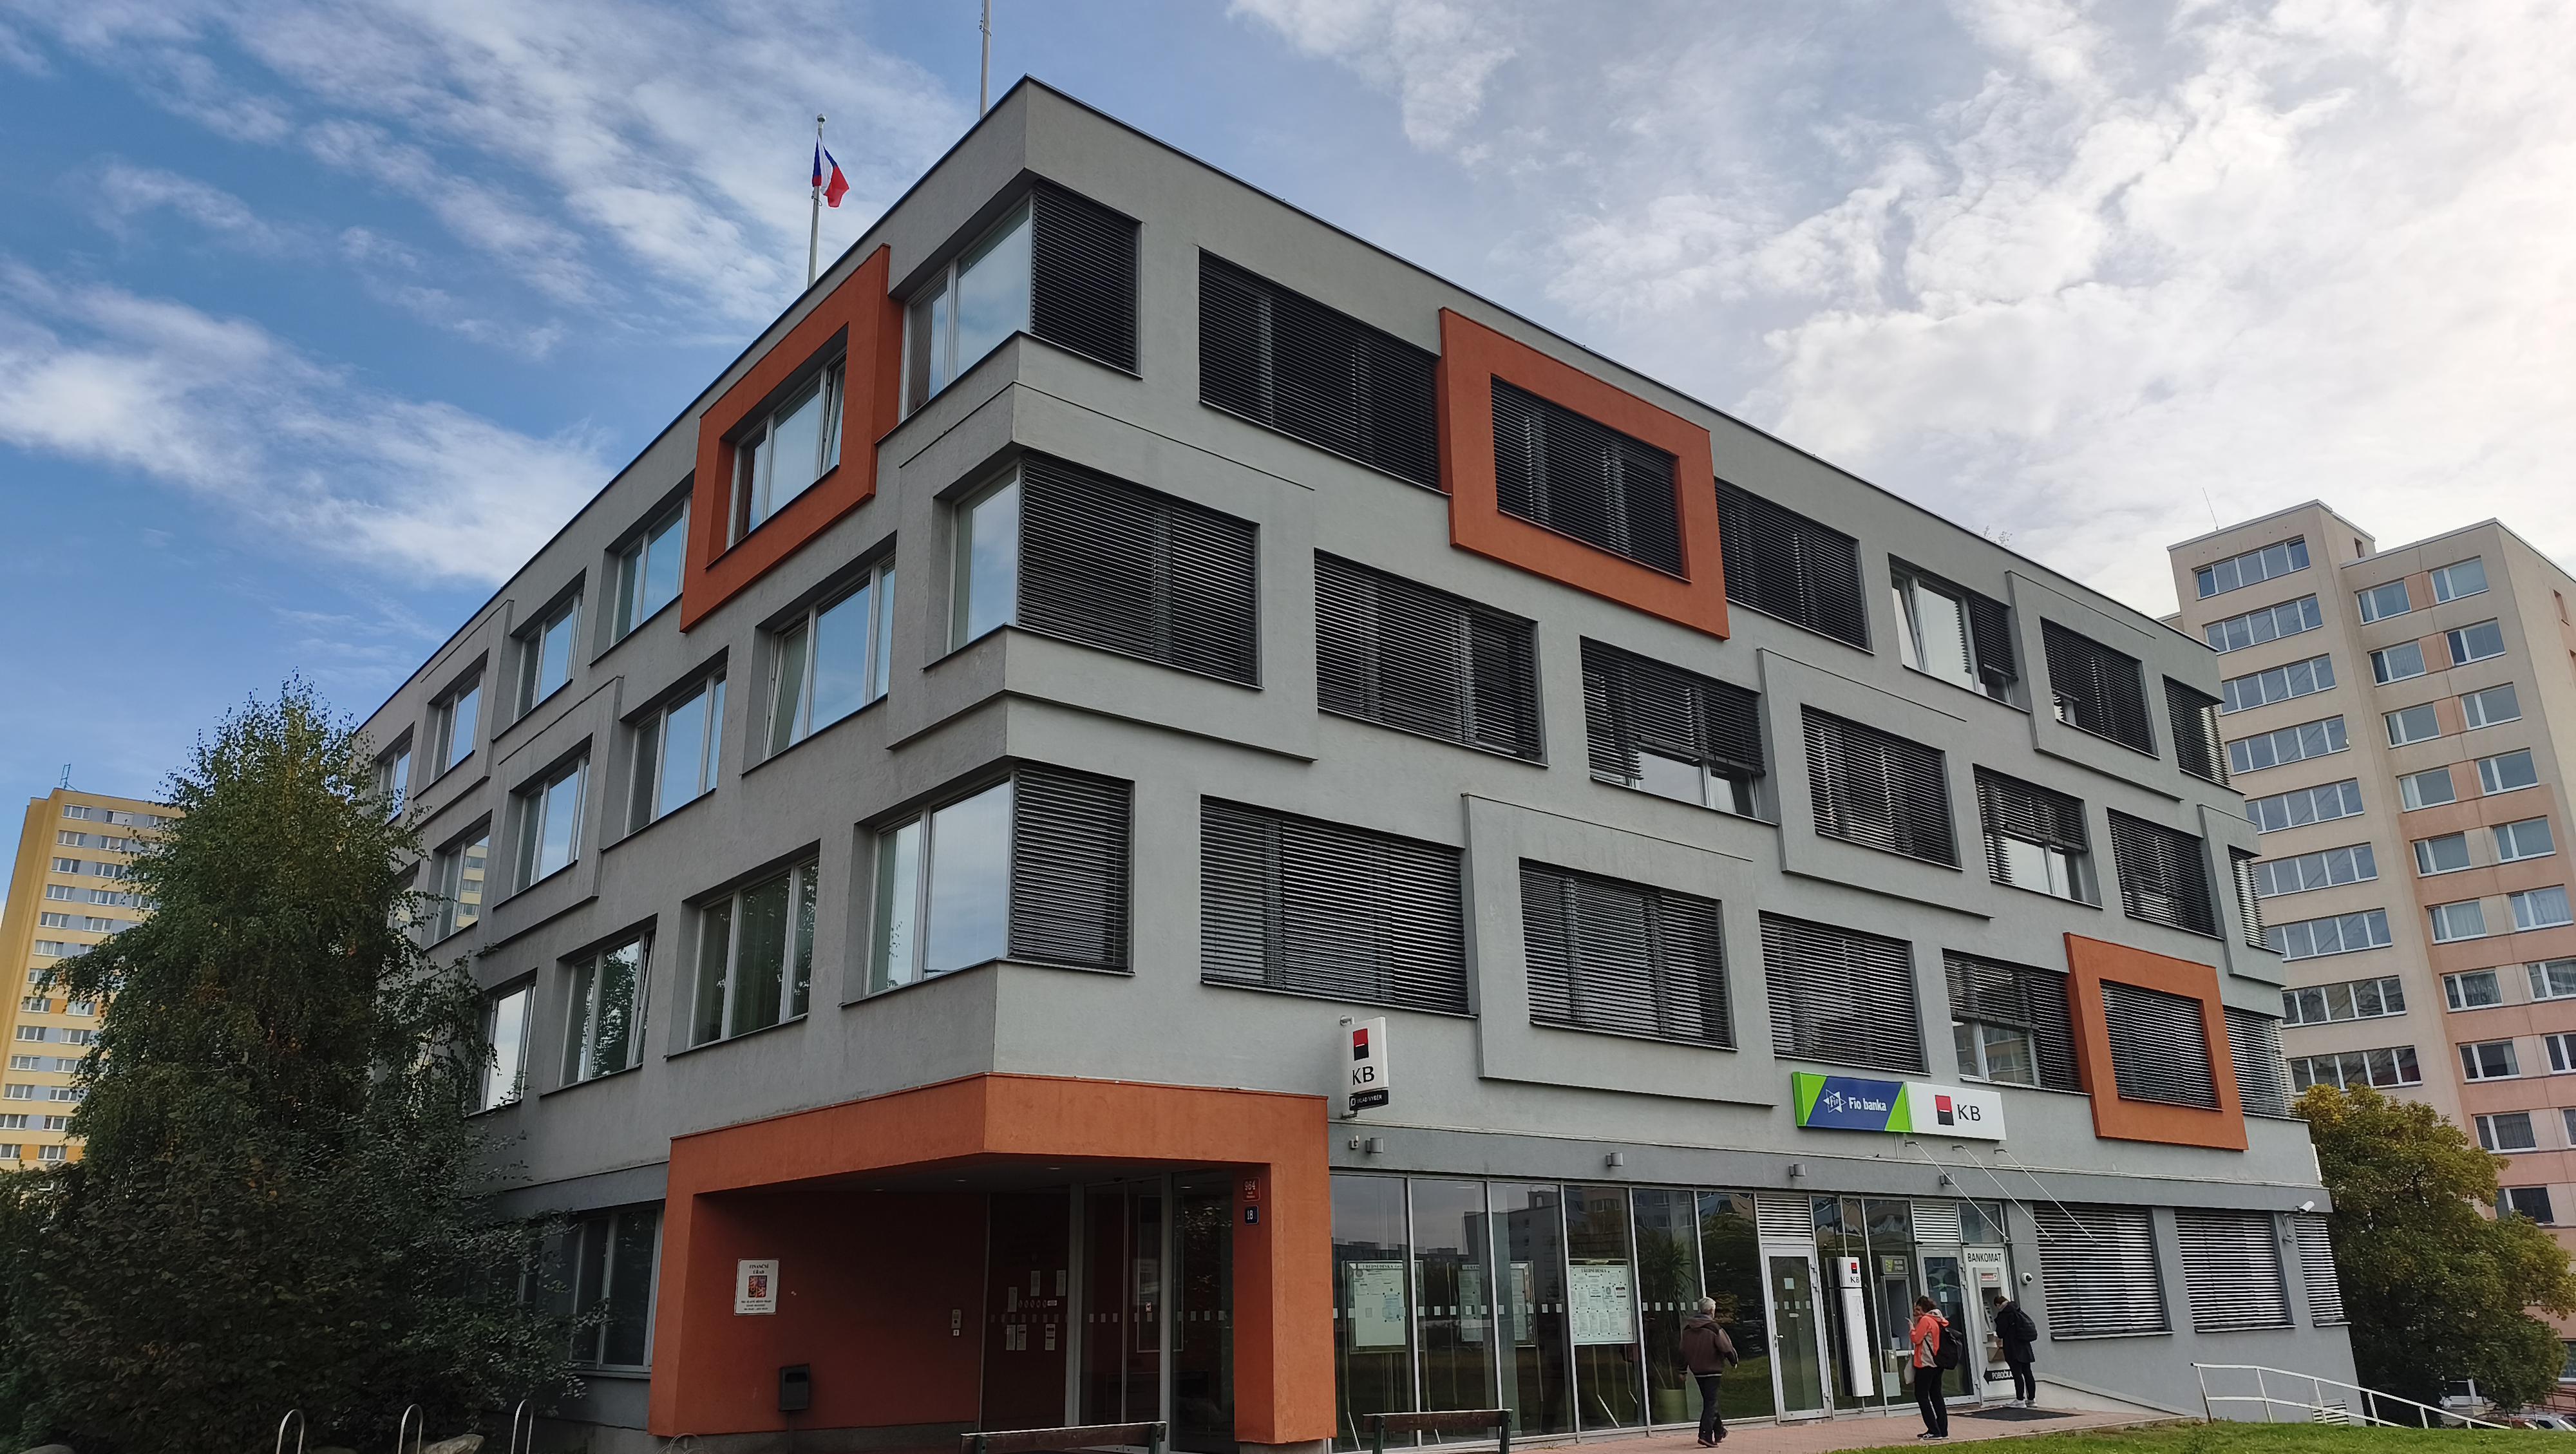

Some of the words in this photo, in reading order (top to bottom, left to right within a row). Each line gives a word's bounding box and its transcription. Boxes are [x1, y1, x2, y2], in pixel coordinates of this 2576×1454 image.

[1352, 1066, 1375, 1086] KB
[1829, 1095, 1839, 1108] Fio
[1848, 1096, 1862, 1109] Fio
[1862, 1097, 1887, 1111] banka
[1957, 1104, 1981, 1121] KB
[1247, 1210, 1253, 1220] 18
[1967, 1252, 2001, 1262] BANKOMAT
